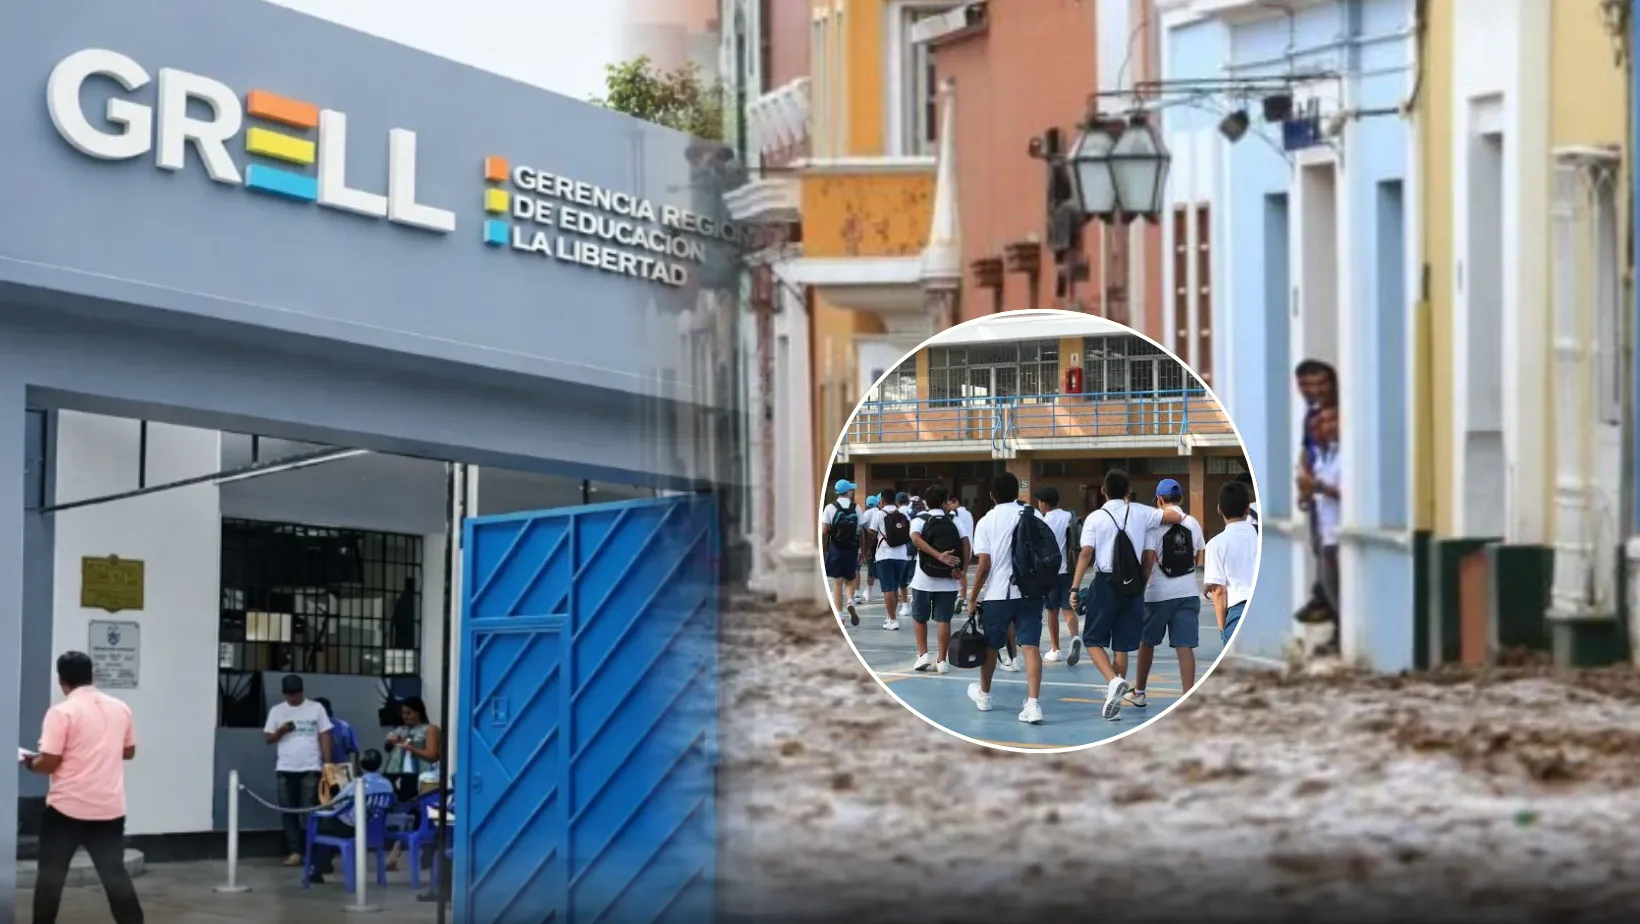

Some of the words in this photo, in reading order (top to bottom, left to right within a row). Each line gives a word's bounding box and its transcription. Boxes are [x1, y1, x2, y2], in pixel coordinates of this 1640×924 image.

[47, 48, 456, 232] GRELL
[513, 166, 656, 222] GERENCIA
[513, 195, 553, 224] DE
[512, 226, 552, 256] LA
[556, 236, 688, 286] LIBERTAD
